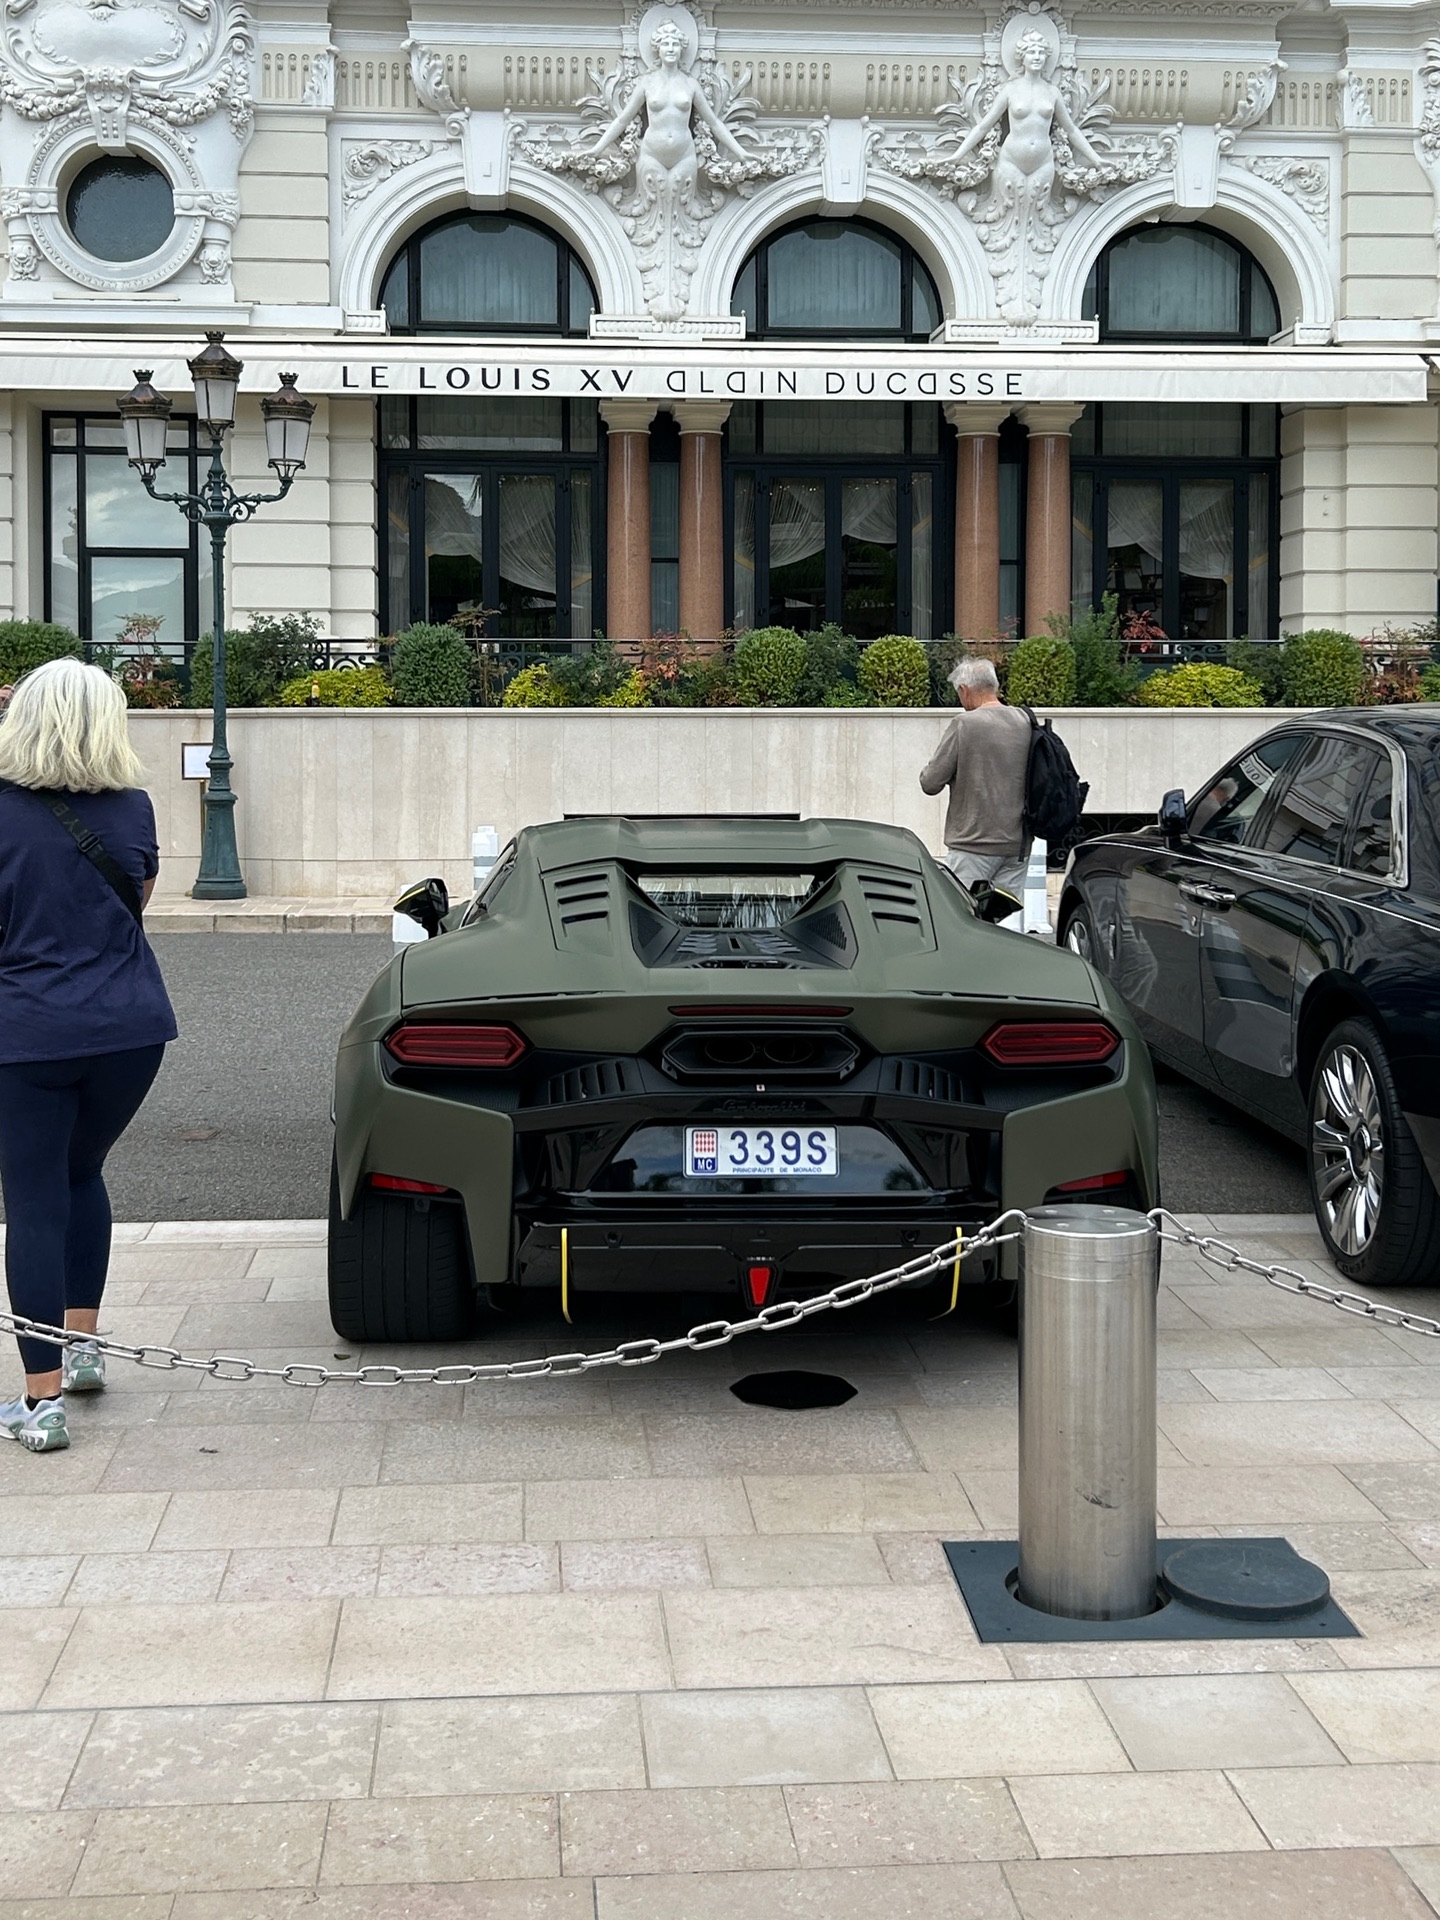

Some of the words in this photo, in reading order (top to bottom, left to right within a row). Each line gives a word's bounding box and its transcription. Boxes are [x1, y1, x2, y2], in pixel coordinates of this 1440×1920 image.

[342, 365, 389, 389] LE
[419, 366, 551, 391] LOUIS
[579, 369, 634, 392] XV
[729, 1130, 827, 1165] 339S
[697, 1159, 713, 1171] MC
